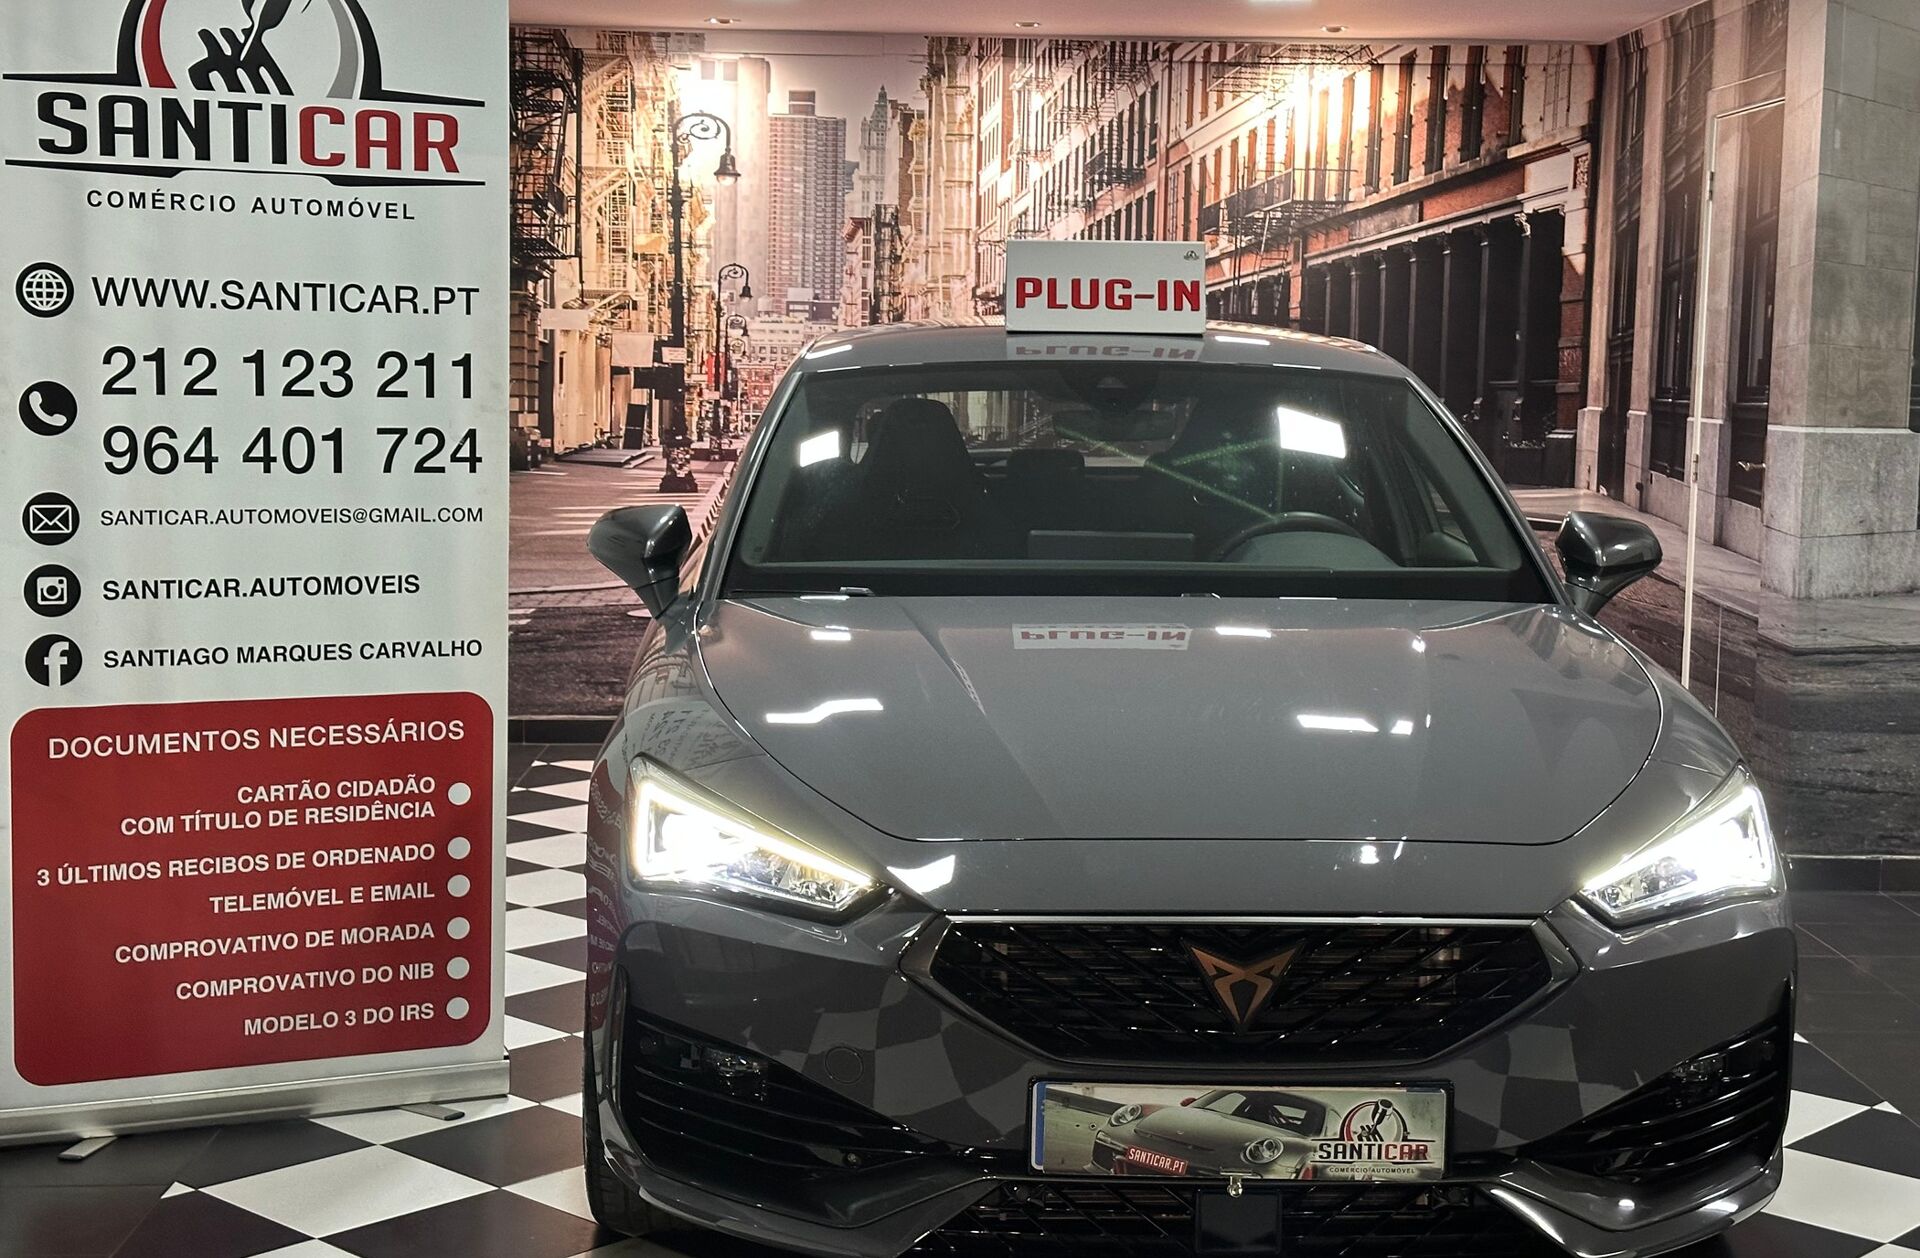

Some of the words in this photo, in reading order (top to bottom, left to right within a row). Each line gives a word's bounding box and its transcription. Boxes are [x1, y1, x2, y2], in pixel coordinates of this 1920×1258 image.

[38, 92, 459, 173] SANTICAR
[87, 189, 236, 213] COMÉRCIO
[251, 197, 415, 220] AUTOMÓVEL
[92, 277, 479, 315] WWW.SANTICAR.PT
[1016, 277, 1200, 312] PLUG-IN
[102, 346, 217, 396] 212
[243, 350, 353, 398] 123
[377, 351, 472, 399] 211
[103, 426, 218, 475] 964
[242, 427, 343, 475] 401
[377, 427, 483, 474] 724
[101, 507, 483, 527] SANTICAR.AUTOMOVEIS@GMAIL.COM
[103, 574, 420, 600] SANTICAR.AUTOMOVEIS
[104, 647, 229, 668] SANTIAGO
[237, 643, 353, 664] MARQUES
[360, 639, 483, 660] CARVALHO
[49, 729, 260, 759] DOCUMENTOS
[270, 718, 465, 748] NECESSÁRIOS
[237, 780, 330, 804] CARTÃO
[337, 774, 435, 798] CIDADÃO
[121, 817, 174, 836] COM
[181, 810, 261, 832] TÍTULO
[269, 809, 298, 827] DE
[306, 801, 435, 824] RESIDÊNCIA
[37, 869, 50, 887] 3
[58, 862, 161, 885] ÚLTIMOS
[169, 855, 269, 878] RECIBOS
[277, 852, 305, 869] DE
[313, 843, 435, 868] ORDENADO
[209, 887, 344, 913] TELEMÓVEL
[351, 887, 363, 904] E
[371, 882, 435, 901] EMAIL
[115, 933, 298, 964] COMPROVATIVO
[306, 930, 334, 948] DE
[341, 923, 435, 945] MORADA
[176, 969, 355, 1000] COMPROVATIVO
[362, 966, 393, 984] DO
[400, 963, 434, 981] NIB
[245, 1012, 338, 1036] MODELO
[345, 1010, 357, 1027] 3
[364, 1007, 394, 1025] DO
[401, 1003, 434, 1021] IRS
[1128, 1148, 1185, 1173] SANTICAR.PT
[1318, 1143, 1428, 1160] SANTICAR
